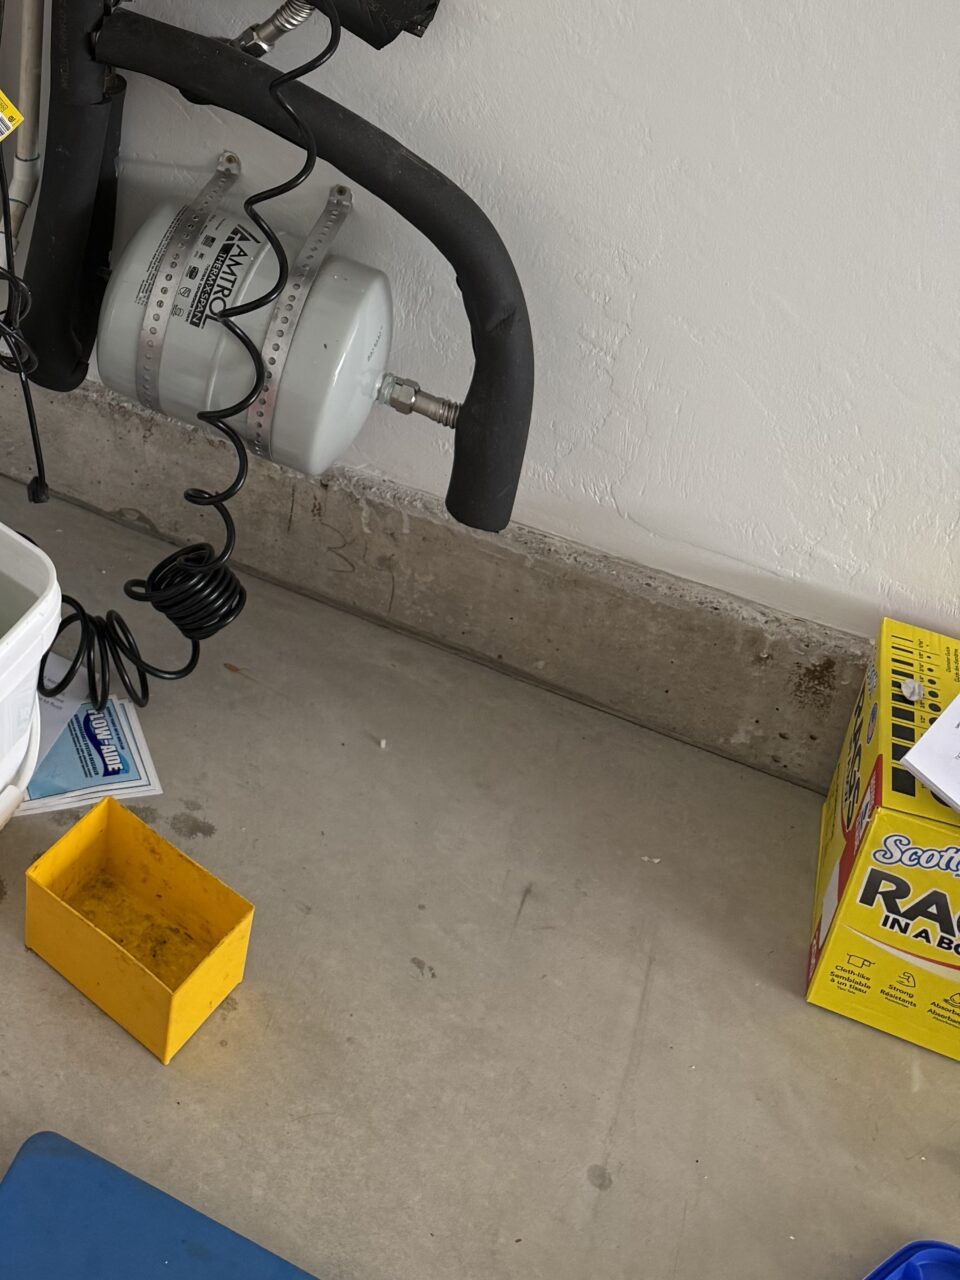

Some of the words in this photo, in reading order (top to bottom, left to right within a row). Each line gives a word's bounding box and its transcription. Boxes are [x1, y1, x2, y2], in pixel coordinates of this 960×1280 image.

[201, 243, 249, 330] AMTROL
[87, 709, 123, 772] FLOW-AIDE
[859, 867, 960, 938] RA
[881, 914, 910, 934] IN
[912, 928, 932, 944] A
[829, 971, 871, 989] Semblable
[835, 964, 871, 981] Cloth-like
[849, 984, 868, 994] tissu
[887, 983, 915, 999] Strong
